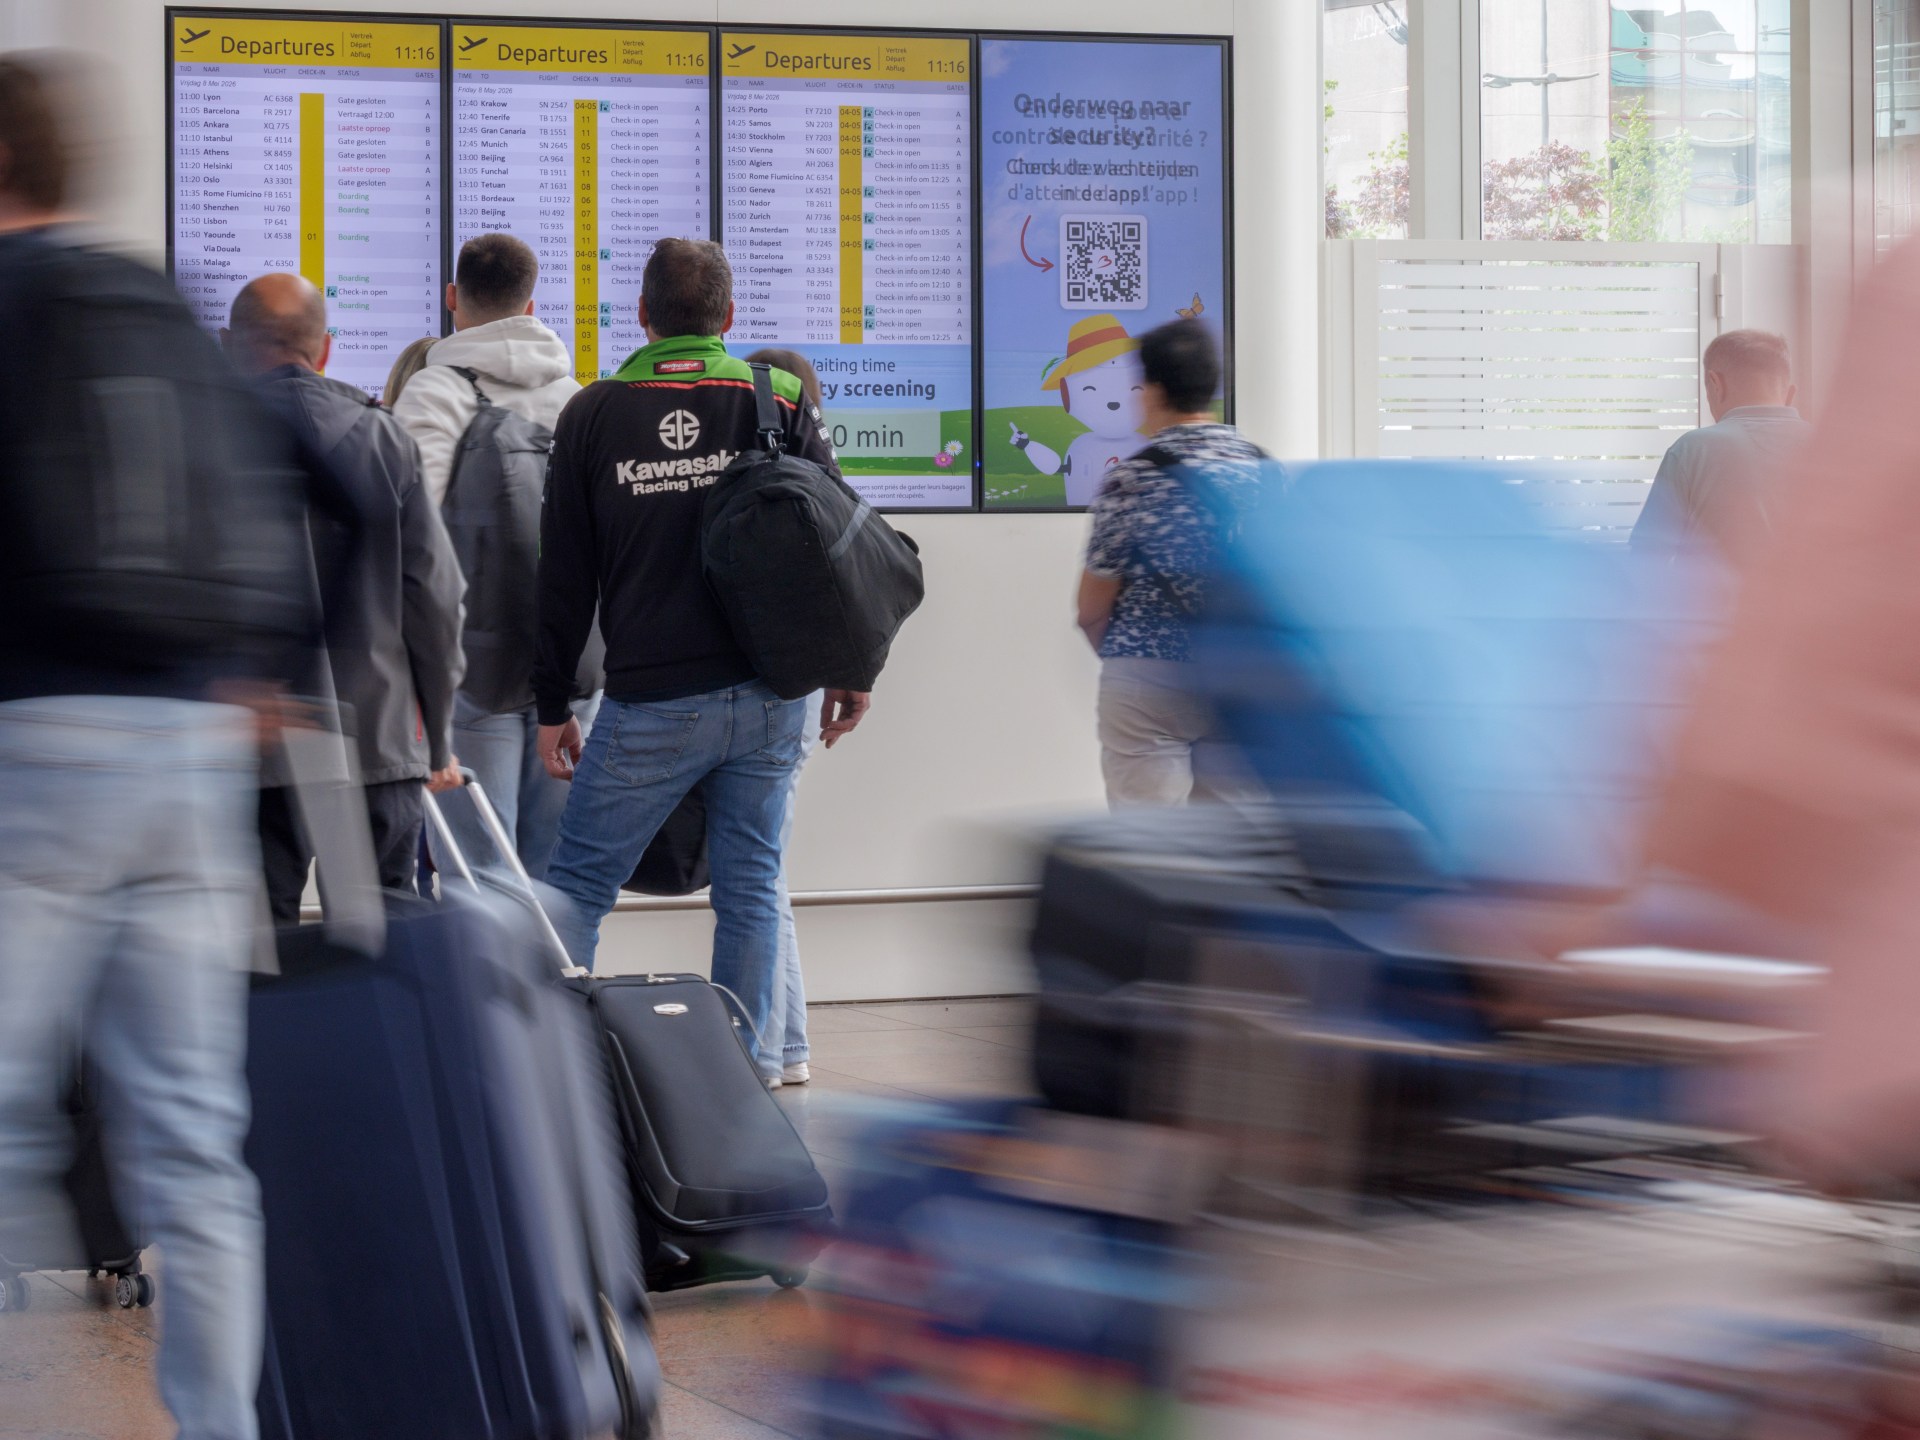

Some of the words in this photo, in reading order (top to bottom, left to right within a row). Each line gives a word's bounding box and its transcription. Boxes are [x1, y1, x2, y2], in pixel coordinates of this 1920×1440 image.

[350, 32, 374, 40] Vertrek
[221, 36, 335, 58] Departures
[350, 41, 372, 49] Départ
[350, 51, 371, 59] Abflug
[395, 46, 435, 61] 11:16
[497, 43, 608, 65] Departures
[666, 53, 705, 67] 11:16
[765, 50, 872, 72] Departures
[927, 60, 965, 74] 11:16
[263, 67, 286, 75] VLUCHT
[298, 68, 326, 76] CHECK-IN
[337, 69, 360, 77] STATUS
[572, 75, 599, 83] CHECK-IN
[180, 92, 201, 100] 11:00
[203, 93, 221, 102] Lyon
[275, 95, 294, 103] 6368
[337, 96, 355, 104] Gate
[356, 97, 386, 106] gesloten
[458, 99, 479, 107] 12:40
[480, 100, 508, 108] Krakow
[539, 101, 549, 109] SN
[550, 101, 568, 109] 2547
[575, 102, 597, 110] 04-05
[610, 103, 640, 111] Check-in
[1013, 92, 1134, 119] Onderweg
[1142, 100, 1192, 117] naar
[180, 106, 201, 114] 11:05
[203, 107, 240, 115] Barcelona
[263, 108, 273, 116] FR
[337, 110, 373, 120] Vertraagd
[375, 111, 395, 119] 12:00
[748, 106, 768, 114] Porto
[805, 107, 814, 115] EY
[815, 107, 832, 115] 7210
[839, 108, 861, 116] 04-05
[874, 109, 903, 117] Check-in
[480, 113, 511, 121] Tenerife
[203, 121, 229, 129] Ankara
[748, 119, 772, 127] Samos
[499, 127, 526, 135] Canaria
[203, 134, 233, 142] Istanbul
[748, 133, 785, 141] Stockholm
[481, 140, 508, 148] Munich
[203, 148, 230, 156] Athens
[748, 146, 773, 154] Vienna
[481, 154, 506, 163] Beijing
[203, 162, 233, 170] Helsinki
[749, 159, 773, 168] Algiers
[481, 167, 509, 175] Funchal
[203, 176, 220, 184] Oslo
[749, 172, 769, 180] Rome
[770, 173, 804, 181] Fiumicino
[481, 181, 506, 189] Tetuan
[203, 189, 225, 197] Rome
[226, 190, 262, 198] Fiumicino
[749, 186, 776, 194] Geneva
[481, 194, 515, 202] Bordeaux
[203, 203, 239, 211] Shenzhen
[749, 199, 771, 207] Nador
[481, 208, 506, 217] Beijing
[749, 212, 771, 220] Zurich
[203, 217, 228, 225] Lisbon
[481, 222, 512, 231] Bangkok
[728, 225, 747, 233] 15:10
[749, 226, 789, 234] Amsterdam
[874, 227, 904, 235] Check-in
[904, 227, 918, 236] info
[931, 228, 950, 236] 13:05
[203, 231, 236, 239] Yaounde
[338, 233, 370, 243] Boarding
[749, 239, 782, 248] Budapest
[216, 245, 241, 253] Douala
[749, 252, 784, 260] Barcelona
[203, 258, 231, 268] Malaga
[749, 266, 793, 275] Copenhagen
[203, 272, 248, 281] Washington
[749, 279, 771, 287] Tirana
[203, 286, 217, 295] Kos
[749, 292, 770, 300] Dubai
[203, 300, 227, 308] Nador
[750, 332, 778, 340] Alicante
[862, 358, 896, 372] time
[843, 379, 936, 401] screening
[857, 424, 904, 448] min
[616, 449, 741, 485] Kawasak
[632, 479, 689, 496] Racing
[907, 484, 927, 492] garder
[941, 484, 966, 492] bagages
